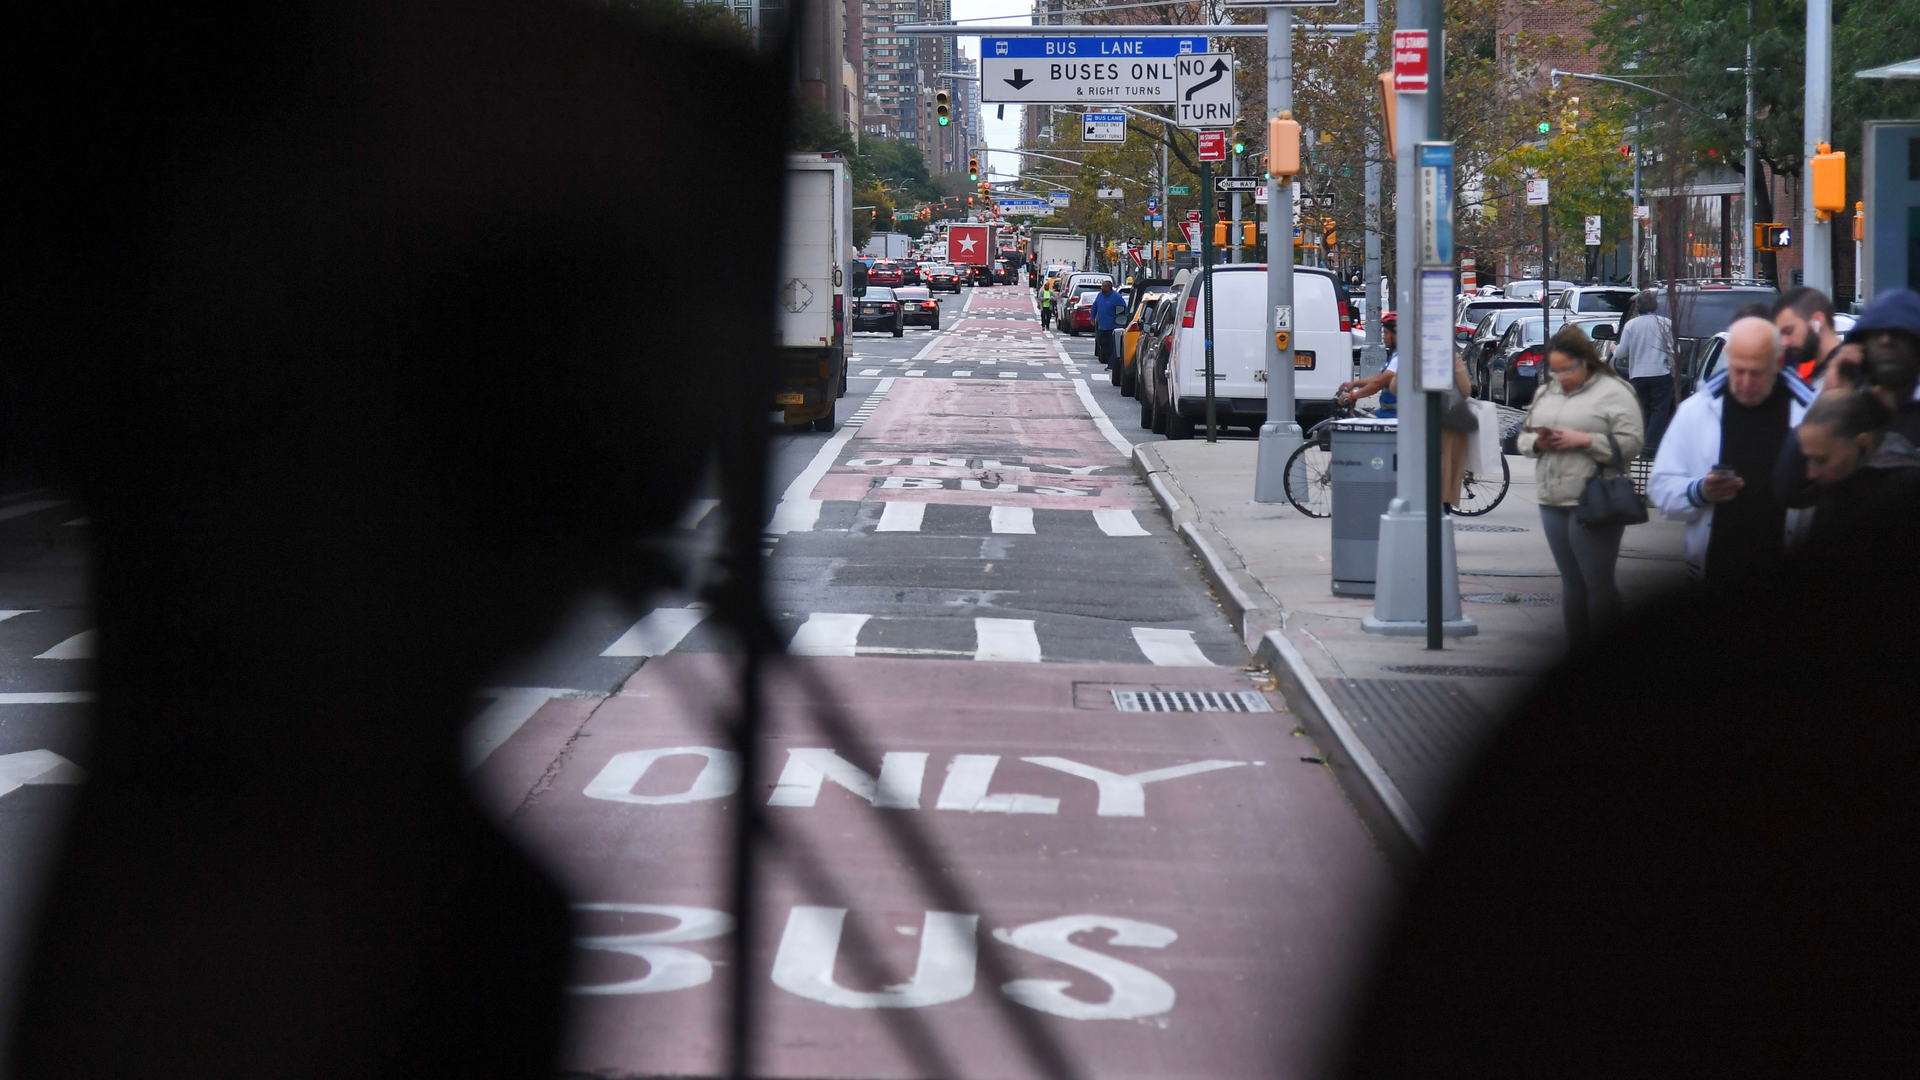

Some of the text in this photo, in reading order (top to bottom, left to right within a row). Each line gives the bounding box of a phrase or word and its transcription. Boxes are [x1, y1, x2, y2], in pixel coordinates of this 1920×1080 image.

[1046, 41, 1144, 55] BUS LANE
[1050, 63, 1176, 80] BUSES ONL
[1179, 59, 1205, 76] NO
[1076, 86, 1161, 96] & RIGHT TURNS
[1181, 103, 1231, 119] TURN
[1424, 169, 1432, 260] BUS STATION
[846, 457, 1111, 475] ONLY
[879, 476, 1097, 497] BUS
[582, 746, 1250, 817] ONLY
[566, 902, 1179, 1021] BUS
